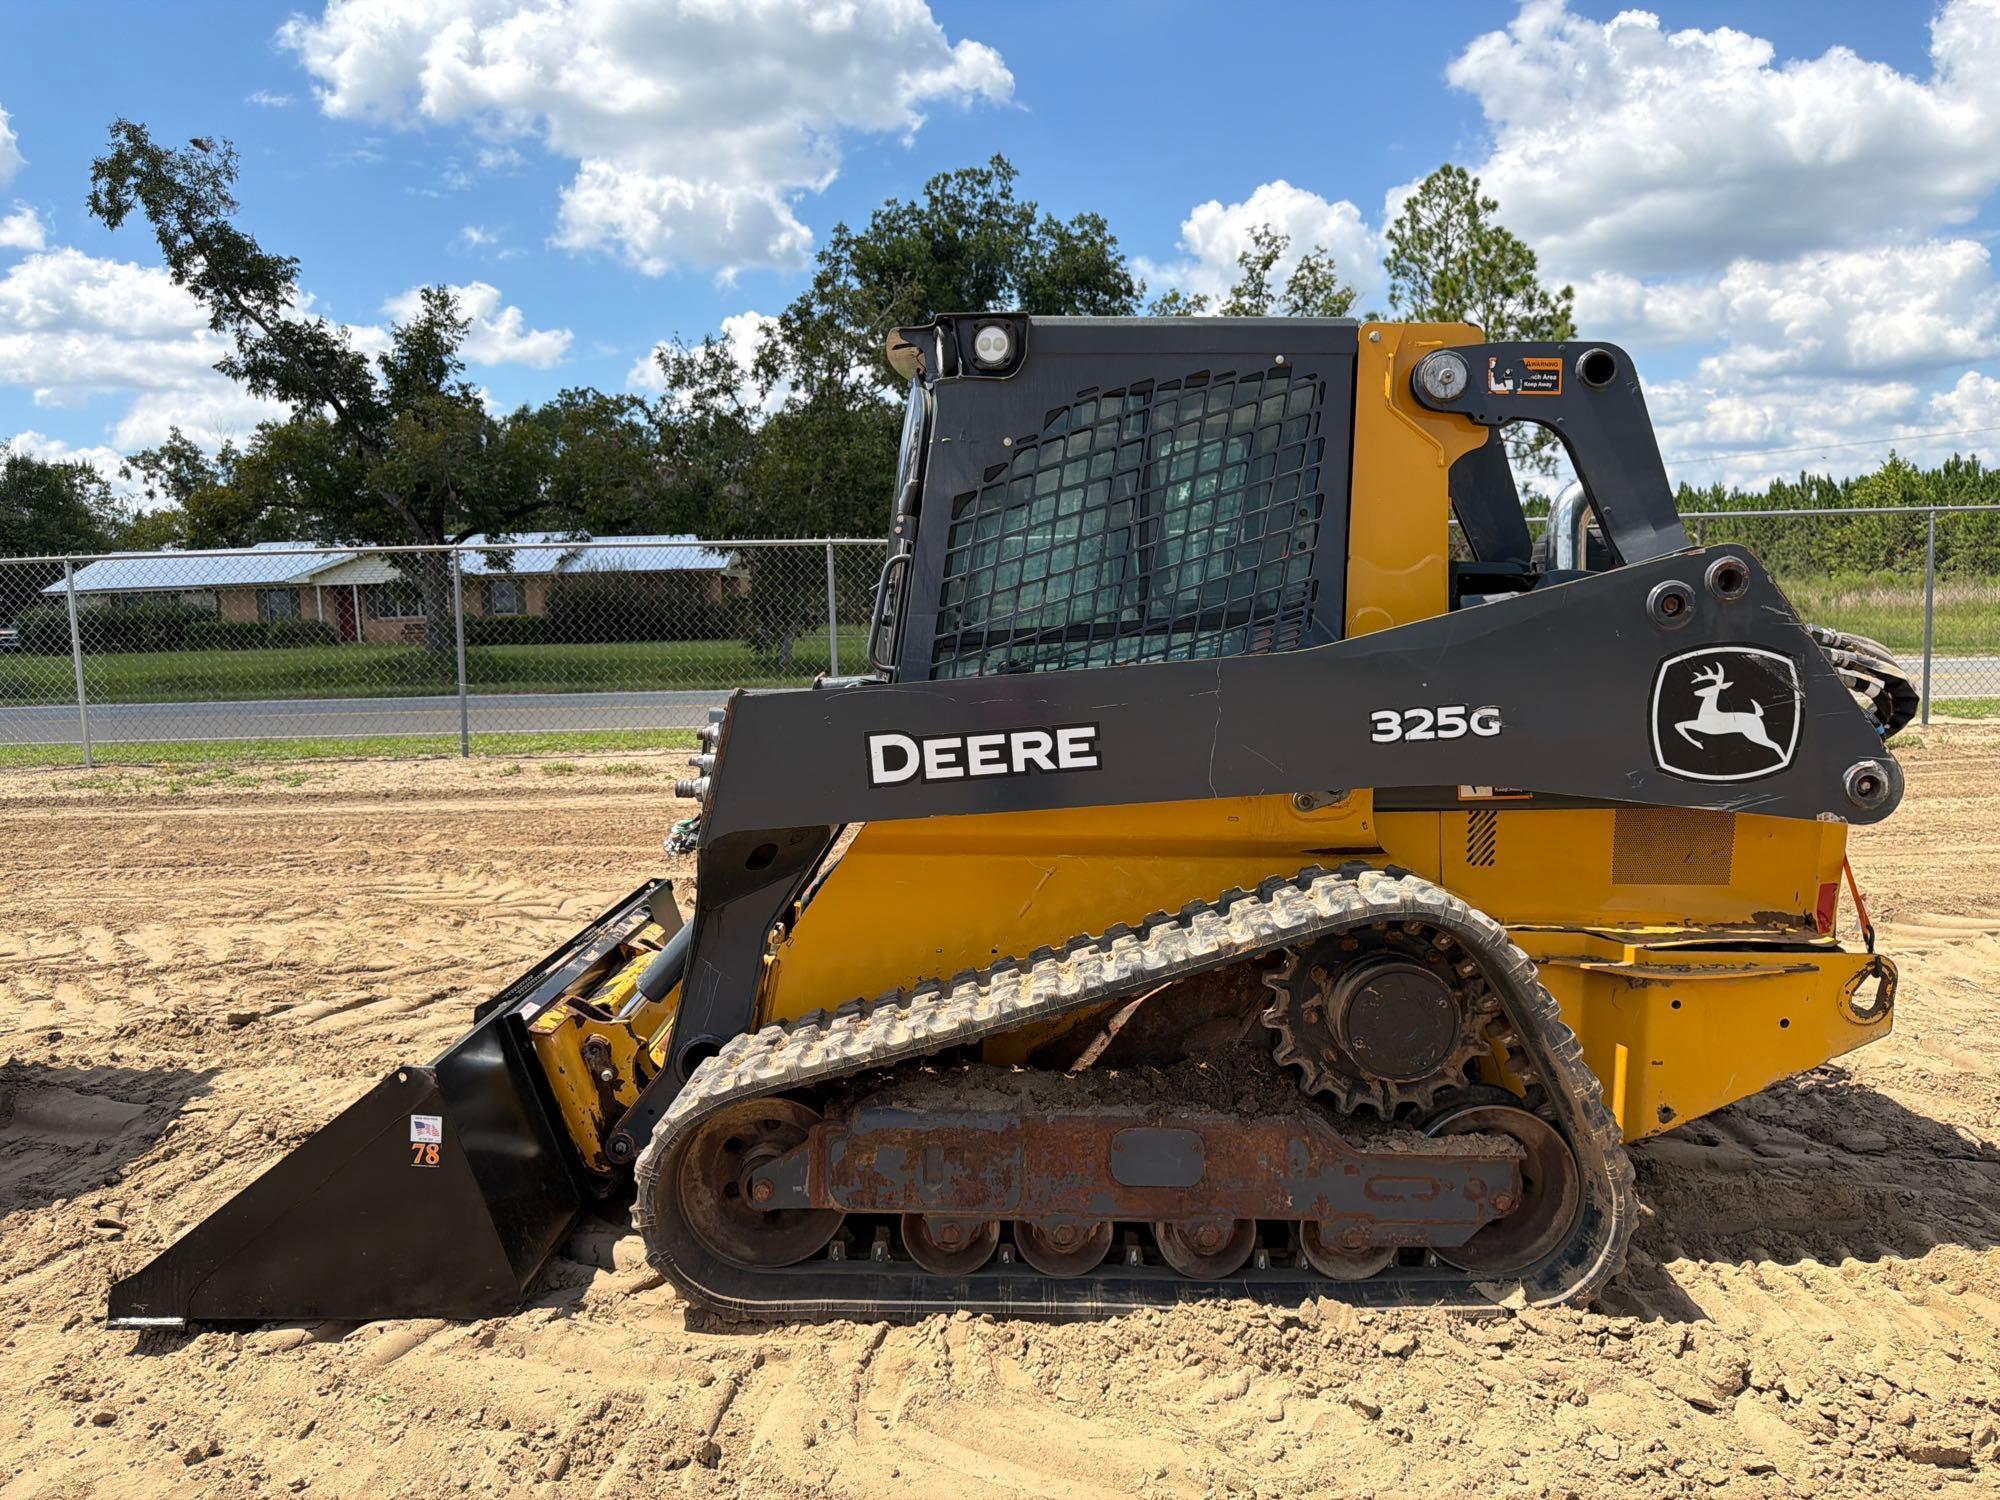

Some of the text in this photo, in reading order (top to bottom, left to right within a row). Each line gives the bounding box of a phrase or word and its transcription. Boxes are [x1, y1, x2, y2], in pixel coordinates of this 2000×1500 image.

[1371, 705, 1502, 743] 325G
[868, 726, 1098, 785] DEERE
[411, 1143, 440, 1164] 78
